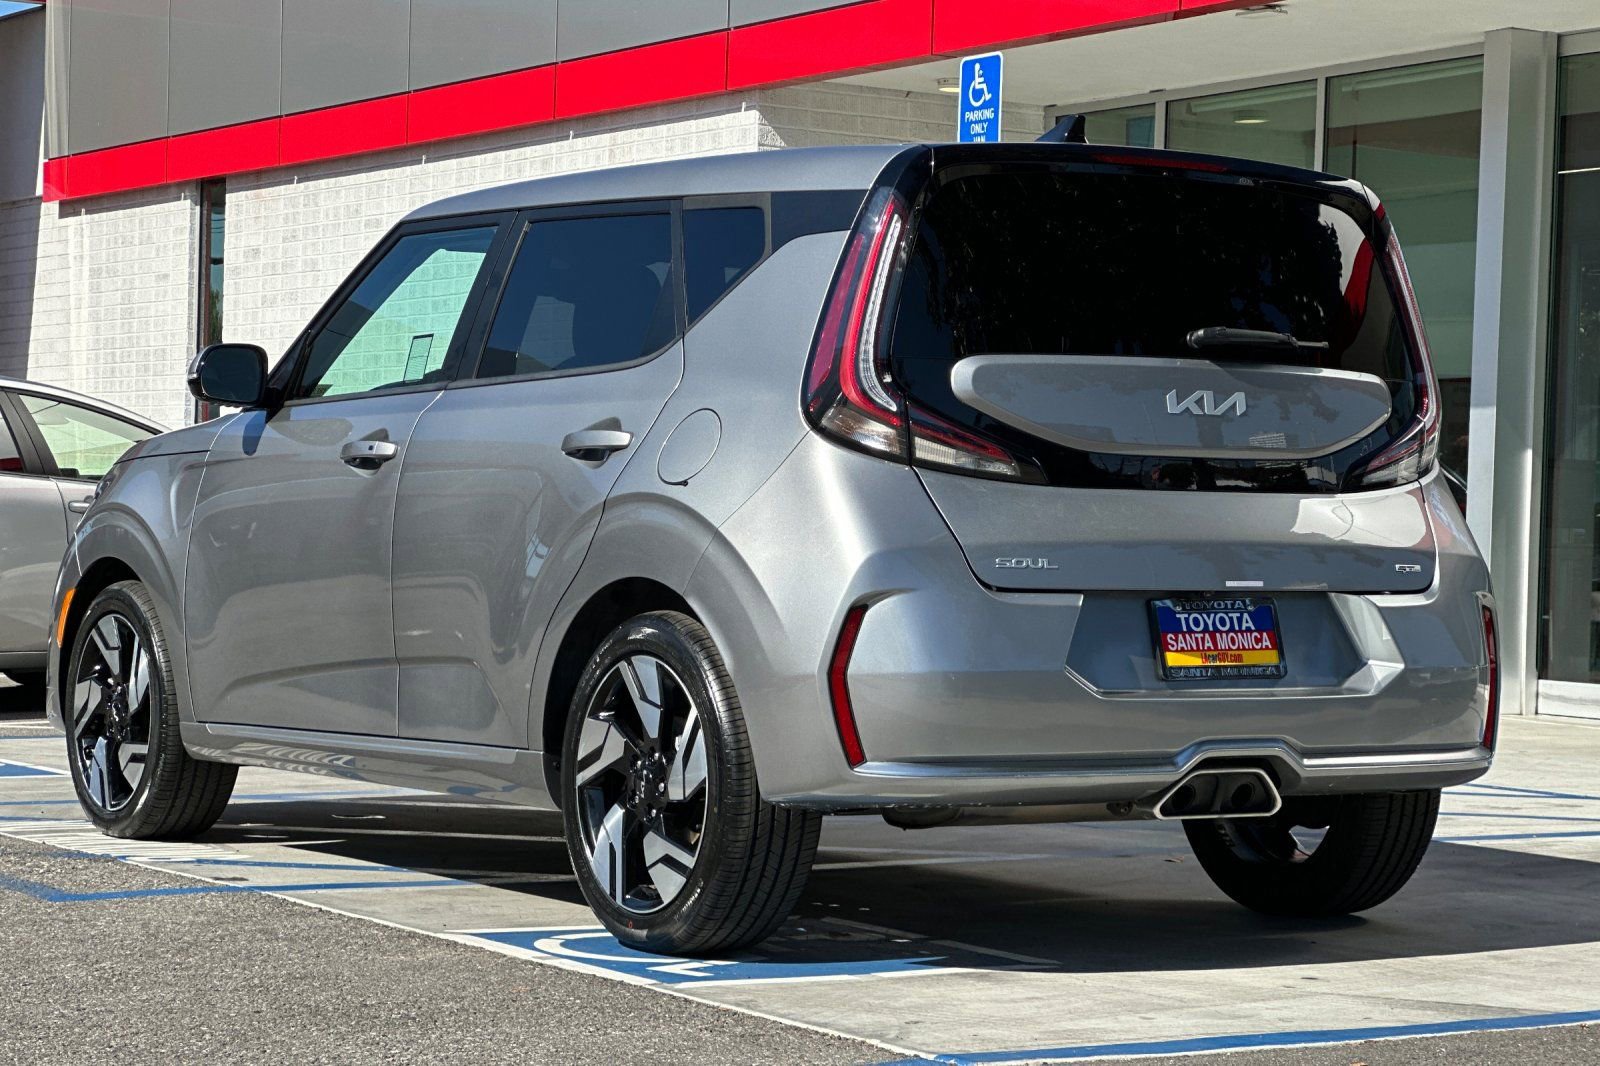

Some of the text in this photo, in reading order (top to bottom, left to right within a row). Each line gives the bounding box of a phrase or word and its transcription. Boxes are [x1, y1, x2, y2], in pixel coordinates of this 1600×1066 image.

[965, 107, 995, 123] PARKING
[970, 122, 988, 134] ONLY
[1166, 389, 1247, 416] KIA
[995, 557, 1059, 569] SOUL
[1182, 600, 1245, 610] TOYOTA
[1175, 612, 1256, 632] TOYOTA
[1166, 632, 1272, 651] SANTA MONICA
[1171, 667, 1216, 678] SANTA
